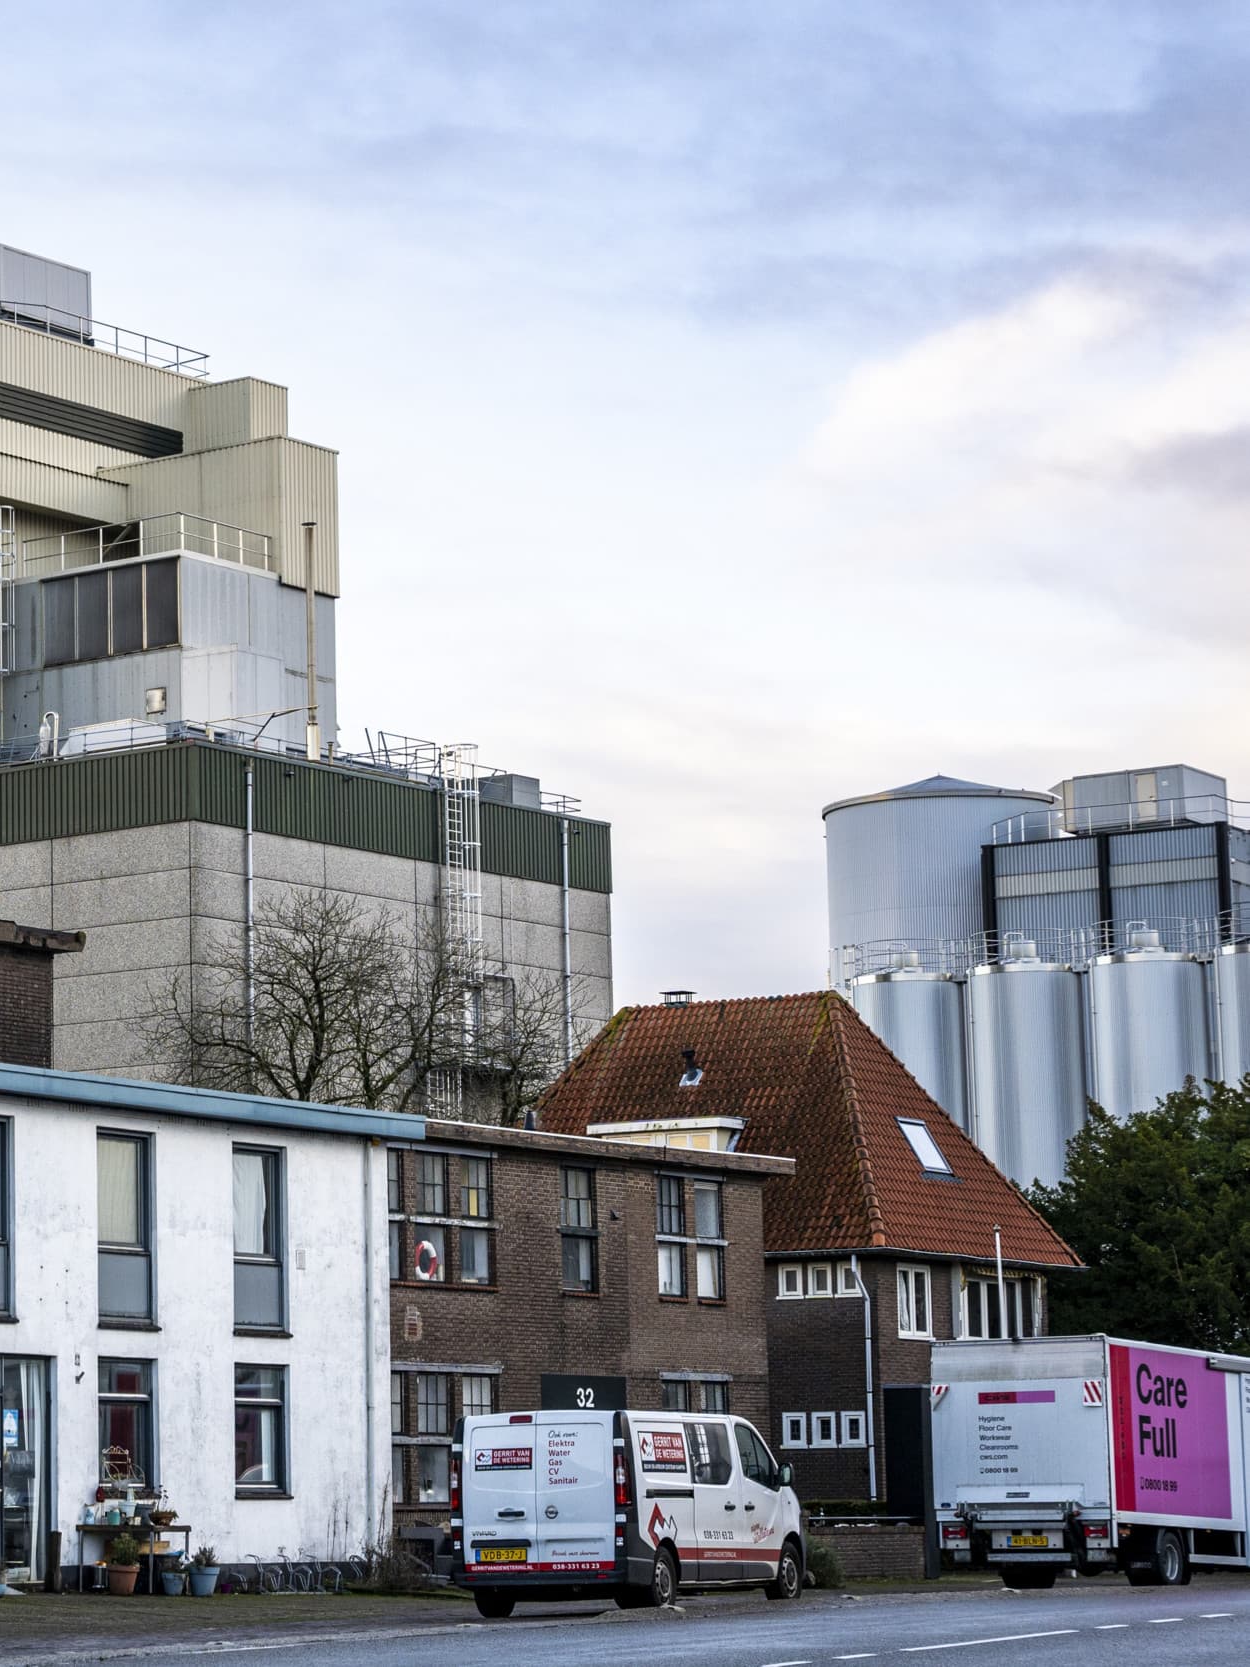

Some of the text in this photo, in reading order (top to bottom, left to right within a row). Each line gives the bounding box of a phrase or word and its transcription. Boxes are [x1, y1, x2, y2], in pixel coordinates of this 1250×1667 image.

[1136, 1363, 1188, 1409] Care
[576, 1387, 595, 1408] 32
[978, 1415, 1005, 1423] Hygiene
[653, 1435, 683, 1448] GERRIT VAN
[1138, 1415, 1178, 1459] Full
[655, 1448, 685, 1459] DE WETERING
[548, 1468, 559, 1476] CV
[548, 1477, 578, 1485] Sanitair
[483, 1551, 523, 1560] VDB-37-J
